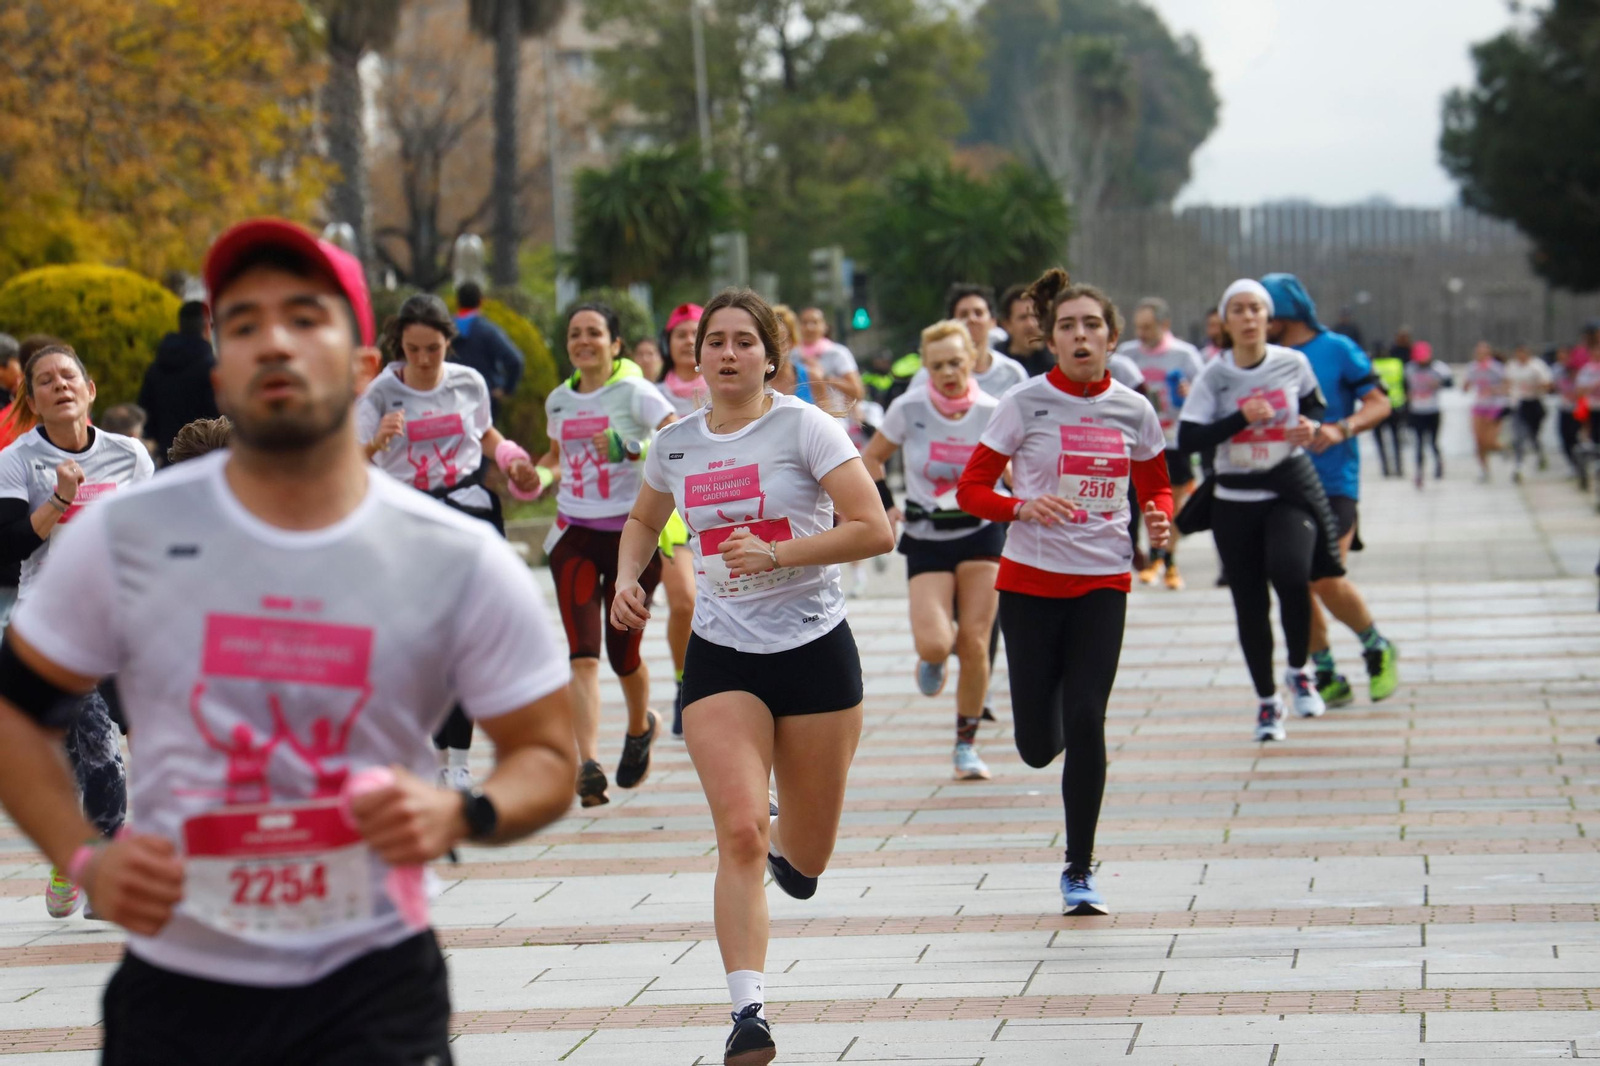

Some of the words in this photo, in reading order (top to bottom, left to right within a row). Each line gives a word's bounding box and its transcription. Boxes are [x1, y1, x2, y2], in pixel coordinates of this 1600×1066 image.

[691, 484, 711, 494] PINK
[713, 477, 751, 491] RUNNING
[1078, 480, 1116, 498] 2518
[702, 491, 729, 501] CADENA
[730, 489, 741, 497] 100
[229, 863, 327, 905] 2254
